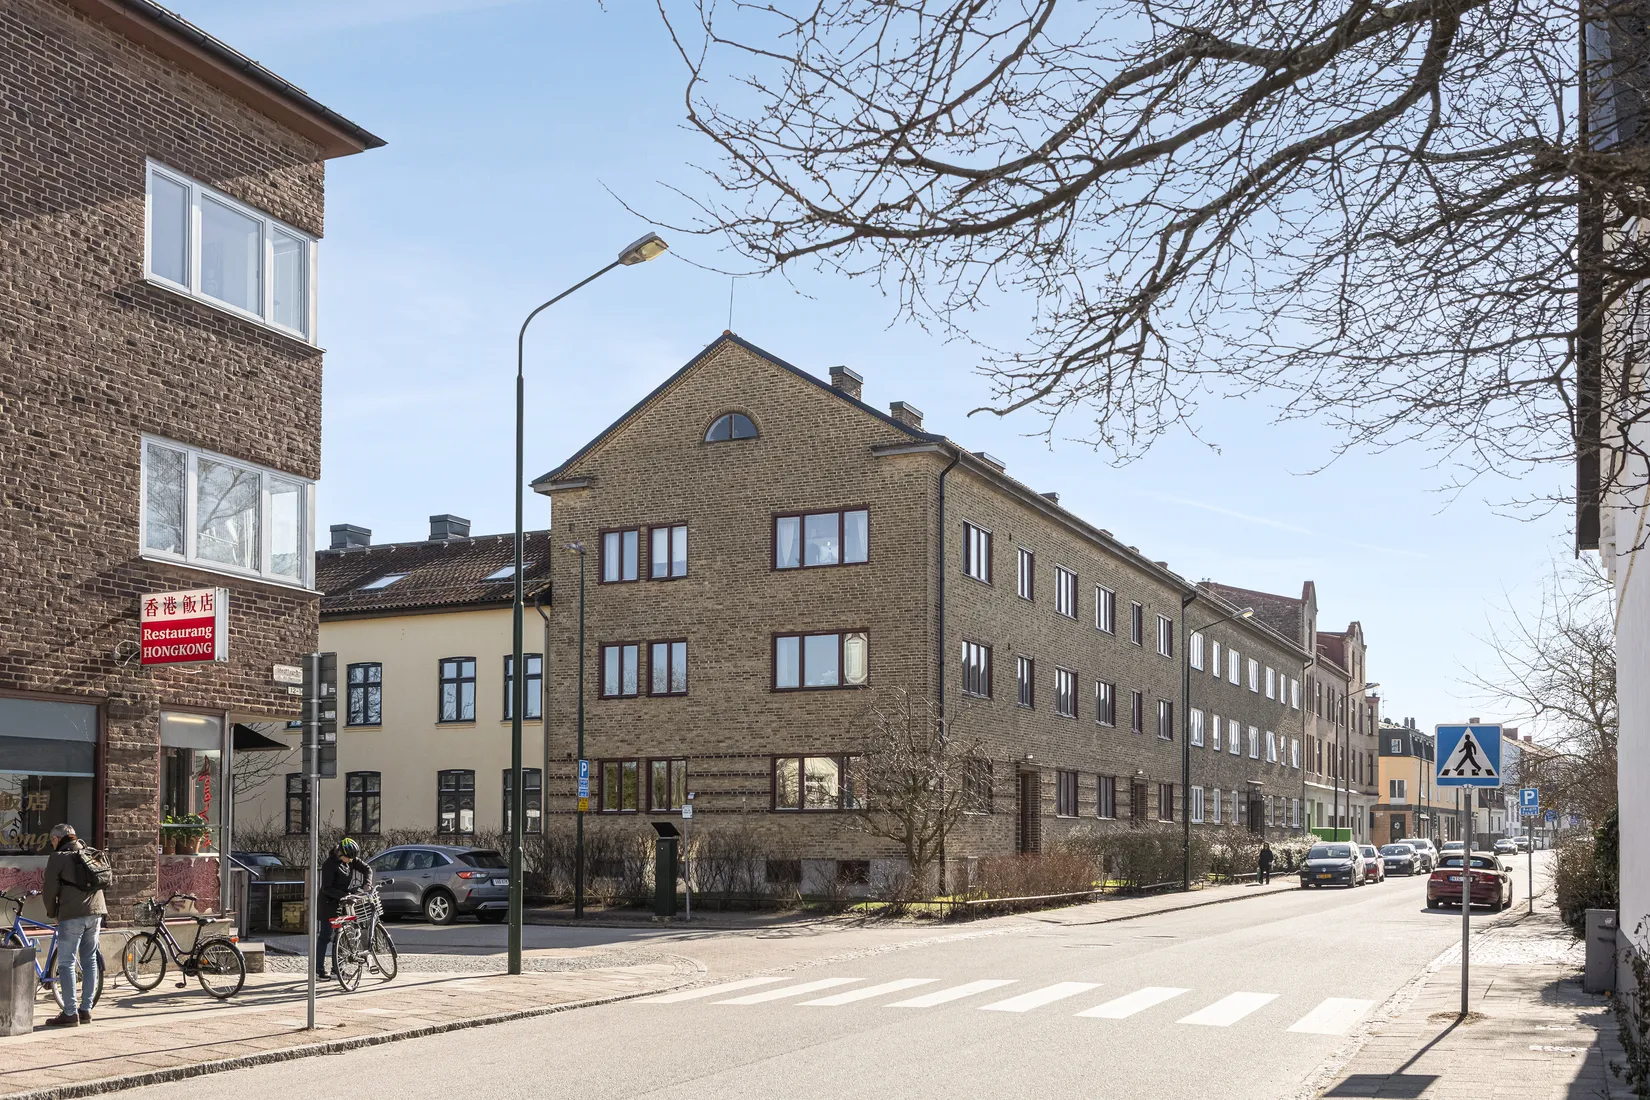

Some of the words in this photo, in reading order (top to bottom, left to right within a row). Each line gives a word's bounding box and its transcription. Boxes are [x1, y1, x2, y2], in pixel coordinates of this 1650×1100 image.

[144, 593, 213, 617] 香港飯店
[143, 626, 213, 641] Restaurang
[143, 642, 212, 658] HONGKONG
[581, 762, 587, 777] P
[1524, 790, 1535, 805] P
